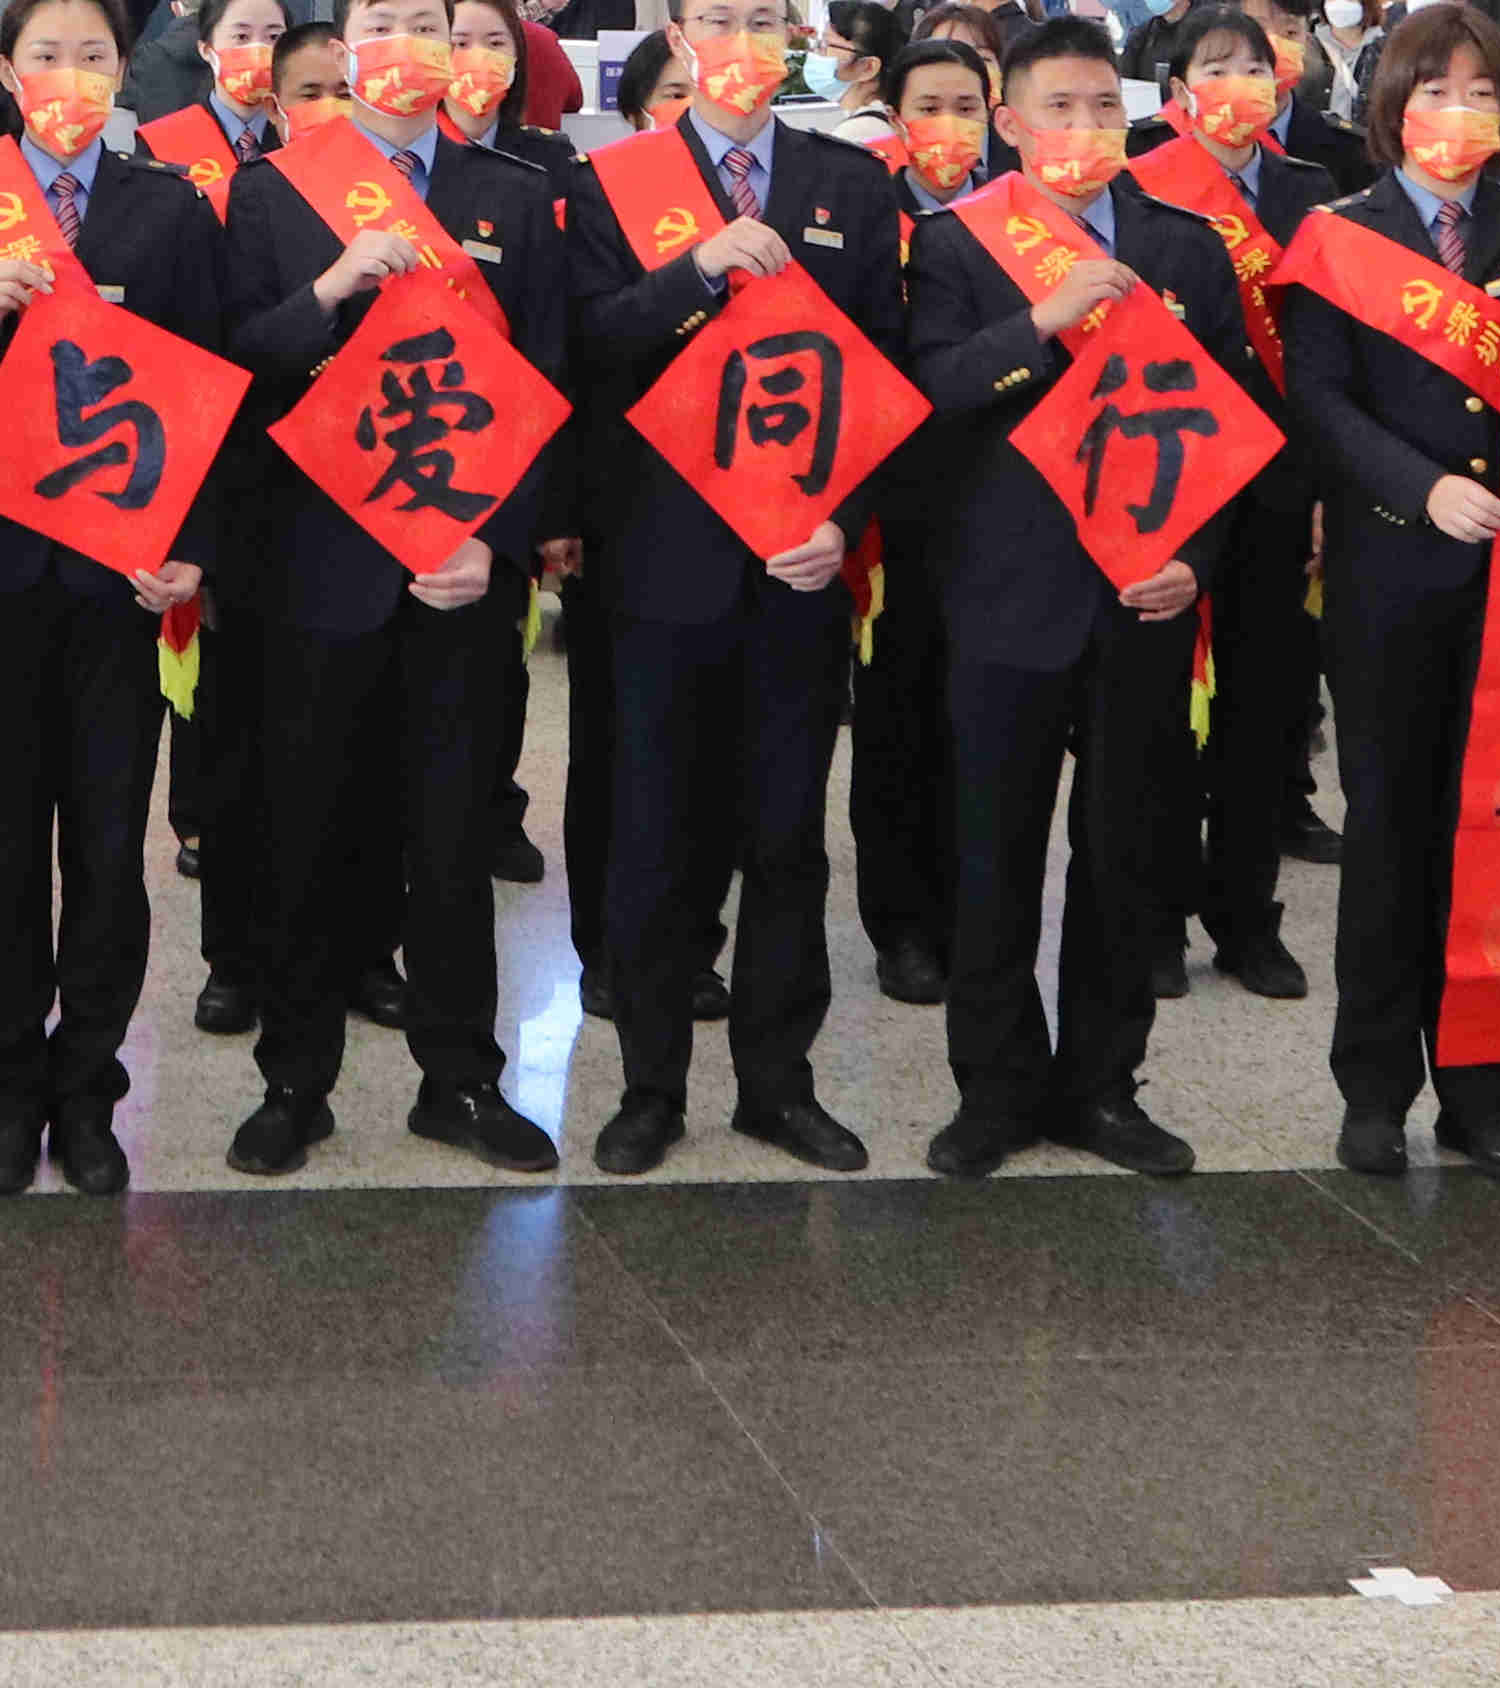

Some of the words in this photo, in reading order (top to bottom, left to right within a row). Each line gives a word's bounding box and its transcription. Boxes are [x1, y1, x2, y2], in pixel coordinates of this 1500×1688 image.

[34, 338, 167, 510] 与
[355, 327, 500, 522] 爱
[713, 330, 843, 497] 同
[1076, 352, 1220, 535] 行
